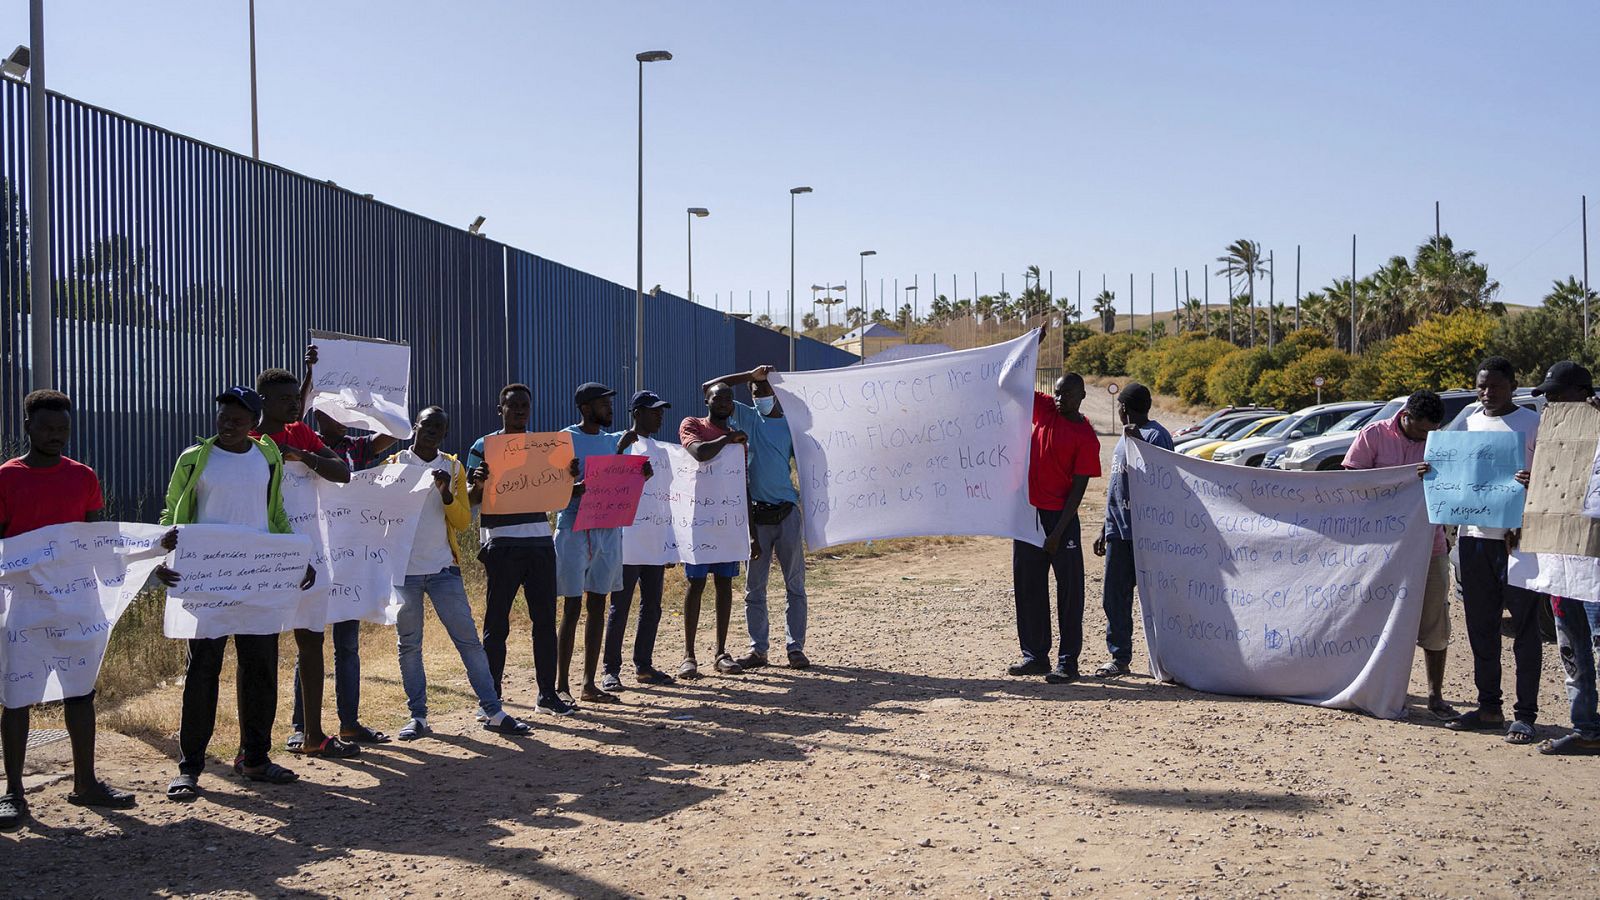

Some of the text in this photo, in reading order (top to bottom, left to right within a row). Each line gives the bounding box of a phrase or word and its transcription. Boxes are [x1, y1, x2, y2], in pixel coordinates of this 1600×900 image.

[798, 386, 849, 412] You
[861, 374, 938, 415] greet
[975, 402, 1005, 429] and
[886, 461, 913, 478] we
[926, 455, 950, 470] are
[959, 444, 1011, 470] black
[847, 491, 887, 509] send
[899, 486, 924, 502] us
[964, 478, 992, 501] hell
[1288, 512, 1309, 538] de
[1272, 550, 1282, 563] a
[1318, 547, 1369, 568] valla
[1262, 586, 1291, 611] ser
[1305, 580, 1409, 610] respetuoso
[78, 657, 87, 666] a
